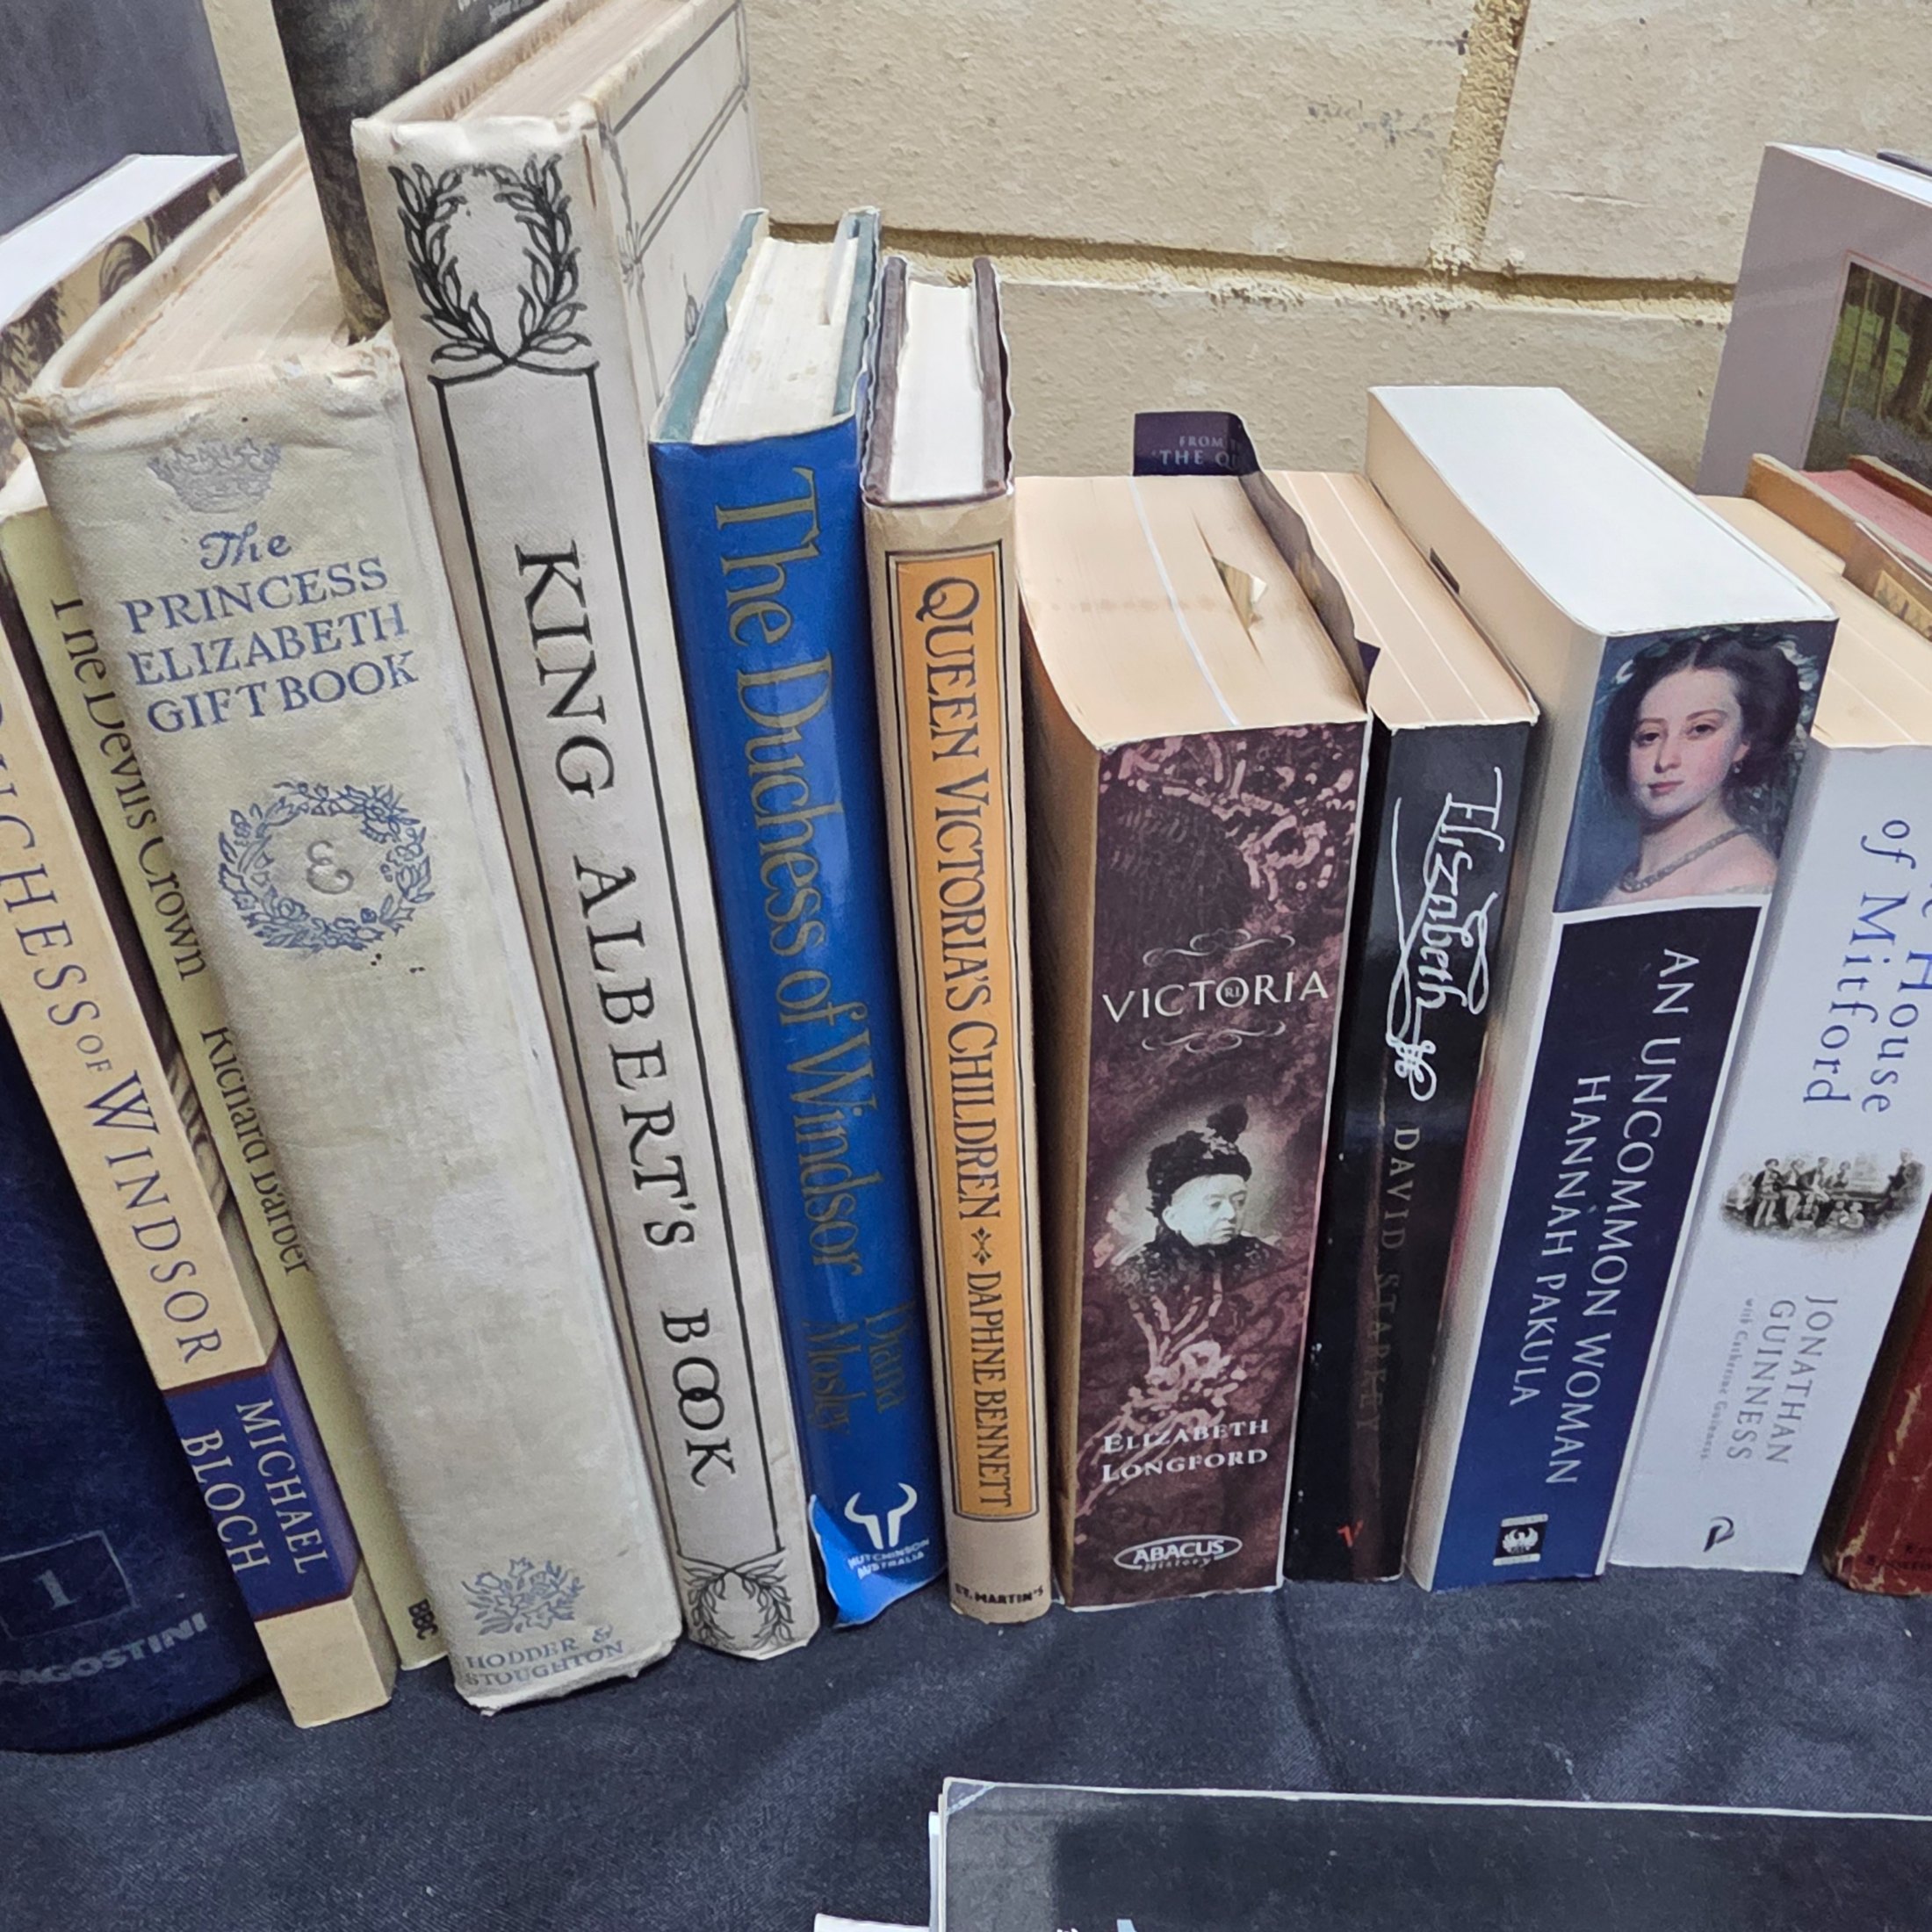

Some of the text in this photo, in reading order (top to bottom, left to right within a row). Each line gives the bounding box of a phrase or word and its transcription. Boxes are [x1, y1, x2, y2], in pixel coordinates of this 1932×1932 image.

[1179, 436, 1223, 448] FROM
[121, 556, 389, 634] PRINCESS
[198, 522, 292, 570] The
[128, 602, 409, 687] ELIZABETH
[147, 650, 420, 733] GIFT BOOK
[715, 467, 884, 1276] The Duchess of Windsor
[915, 576, 1000, 1221] QUEEN VICTORIA'S CHILDREN
[514, 539, 736, 1489] KING ALBERT'S BOOK
[1102, 970, 1329, 1023] VICTORIA
[1803, 819, 1916, 1102] of Mitford
[76, 1034, 112, 1074] OF
[84, 1070, 222, 1364] WINDSOR
[1381, 1128, 1420, 1251] DAVID
[1510, 1074, 1611, 1406] HANNAH PAKULA
[1545, 948, 1699, 1484] AN UNCOMMON WOMAN
[802, 1320, 867, 1435] Mosley
[968, 1271, 1013, 1508] DAPHNE BENNETT
[1727, 1300, 1796, 1459] GUINNESS
[1766, 1295, 1838, 1463] JONATHAN
[181, 1430, 270, 1573] BLOCH
[235, 1398, 328, 1574] MICHAEL
[847, 1539, 929, 1569] HUTCHINSON
[857, 1551, 925, 1579] AUSTRALIA
[1133, 1539, 1225, 1564] ABACUS
[408, 1599, 438, 1640] BBC
[465, 1636, 580, 1669] HODDER
[465, 1640, 624, 1686] STOUGHTON
